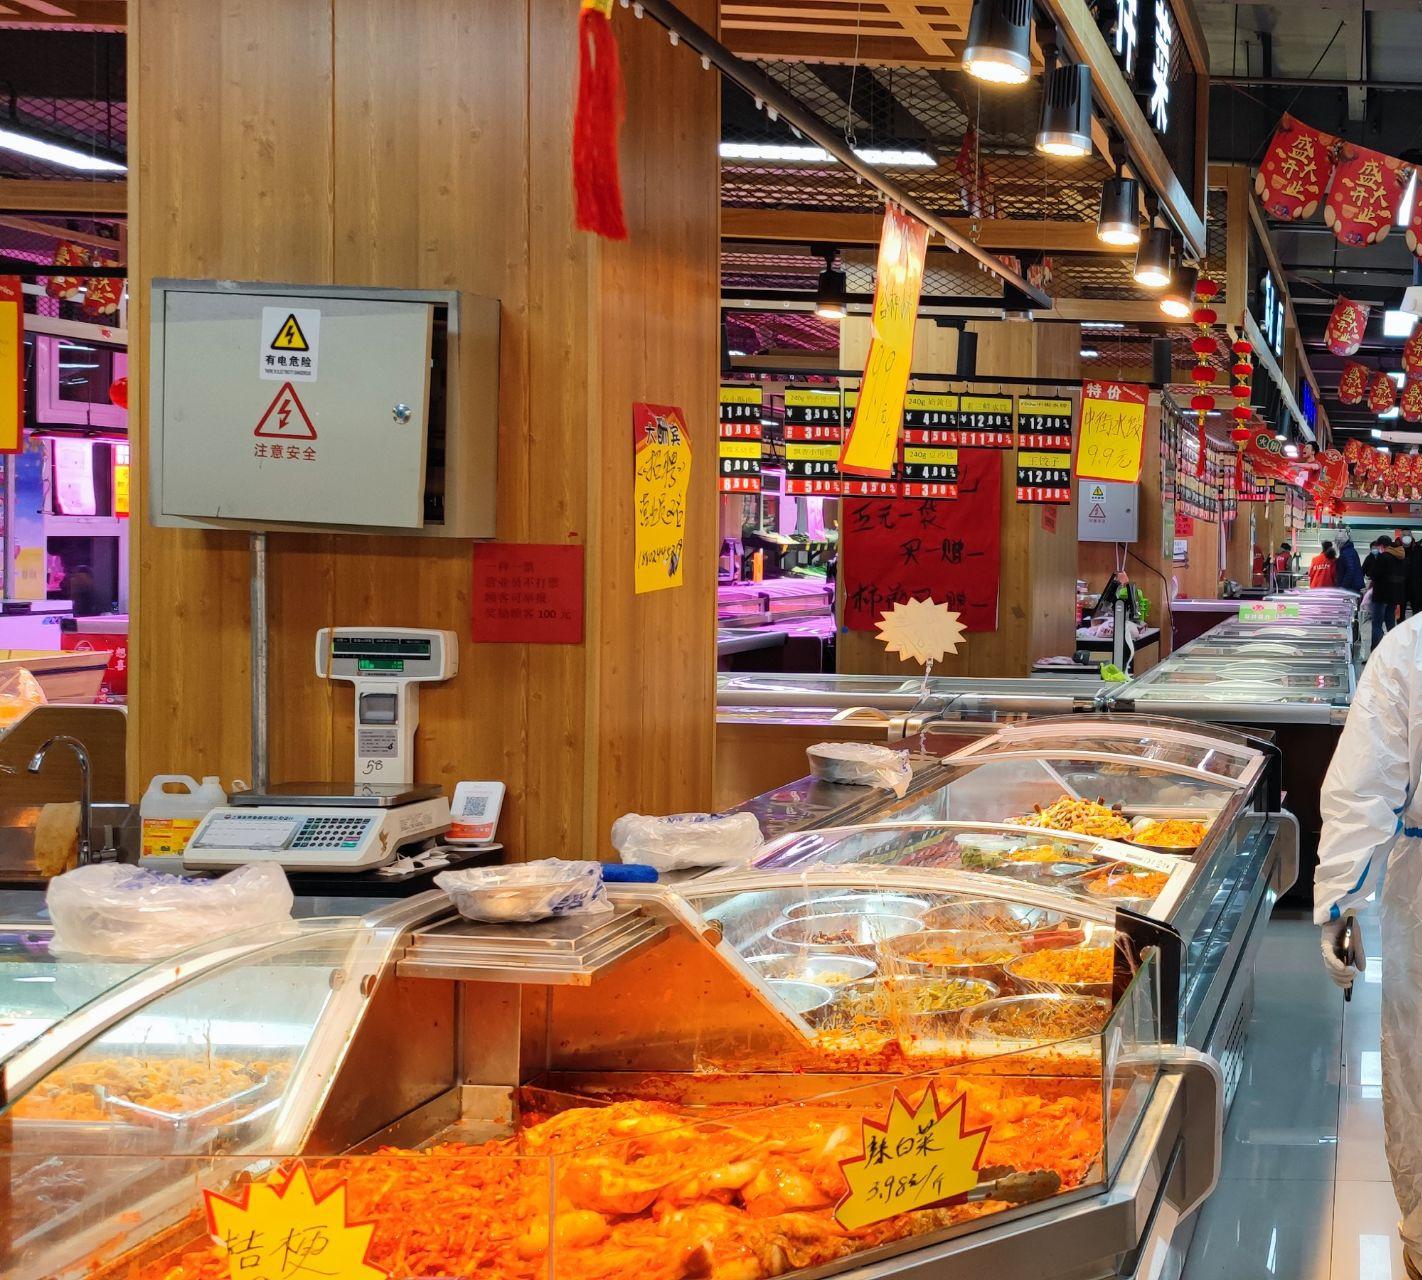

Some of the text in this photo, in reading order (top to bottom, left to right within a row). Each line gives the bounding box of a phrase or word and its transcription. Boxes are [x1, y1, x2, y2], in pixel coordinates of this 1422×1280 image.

[265, 354, 312, 368] 有电危险
[1087, 383, 1122, 400] 特价
[254, 443, 317, 461] 注意安全
